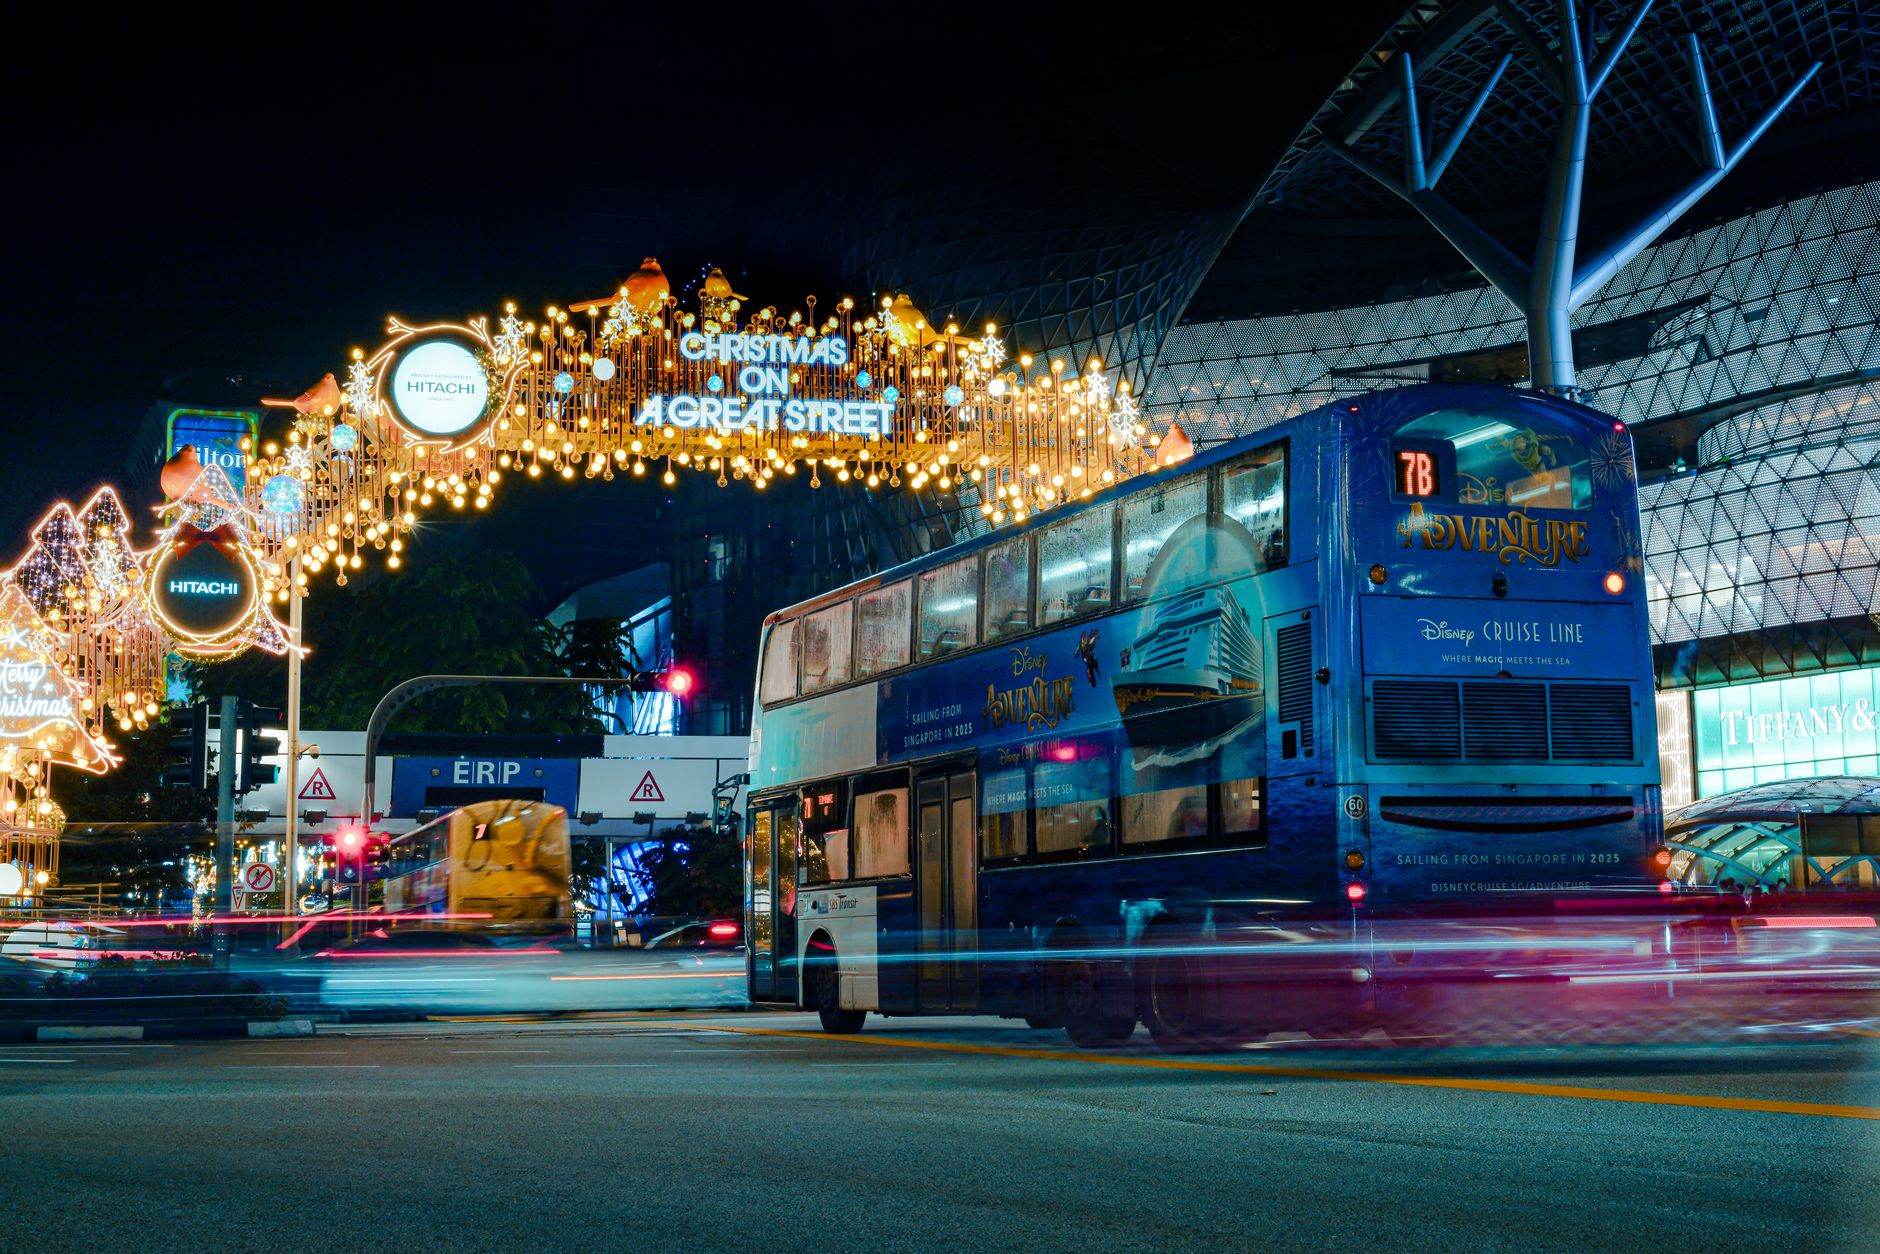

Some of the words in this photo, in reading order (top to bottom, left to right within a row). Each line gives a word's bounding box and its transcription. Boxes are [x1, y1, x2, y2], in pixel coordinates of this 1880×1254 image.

[680, 332, 847, 365] CHRISTMAS
[407, 381, 475, 394] HITACHI
[739, 366, 789, 395] ON
[635, 395, 663, 427] A
[668, 395, 782, 432] GREAT
[786, 399, 895, 434] STREET
[176, 444, 247, 469] ilton
[1401, 452, 1432, 496] 7B
[1397, 502, 1590, 566] ADVENTURE
[170, 581, 238, 594] HITACHI
[1417, 618, 1475, 647] Disney
[1483, 621, 1540, 642] CRUISE
[1550, 623, 1584, 643] LINE
[1011, 645, 1048, 677] Disney
[1442, 654, 1472, 663] WHERE
[1475, 655, 1503, 664] MAGIC
[1506, 656, 1534, 665] MEETS
[1537, 657, 1552, 665] THE
[1555, 657, 1570, 665] SEA
[912, 707, 940, 725] SAILING
[941, 703, 962, 718] FROM
[982, 675, 1075, 734] ADVENTURE
[1720, 703, 1850, 745] TIFFANY
[1852, 697, 1879, 732] &
[903, 728, 942, 748] SINGAPORE
[944, 727, 953, 739] IN
[955, 722, 973, 737] 2025
[312, 781, 323, 796] R
[643, 783, 654, 798] R
[1007, 790, 1027, 803] MAGIC
[1049, 785, 1061, 796] THE
[1061, 782, 1073, 794] SEA
[1348, 798, 1363, 811] 60
[1397, 854, 1449, 865] SAILING
[1455, 854, 1489, 865] FROM
[1495, 854, 1567, 865] SINGAPORE
[1573, 854, 1585, 864] IN
[1590, 852, 1620, 863] 2025
[1431, 880, 1591, 893] DISNEYCRUISESG/ADVENTURE
